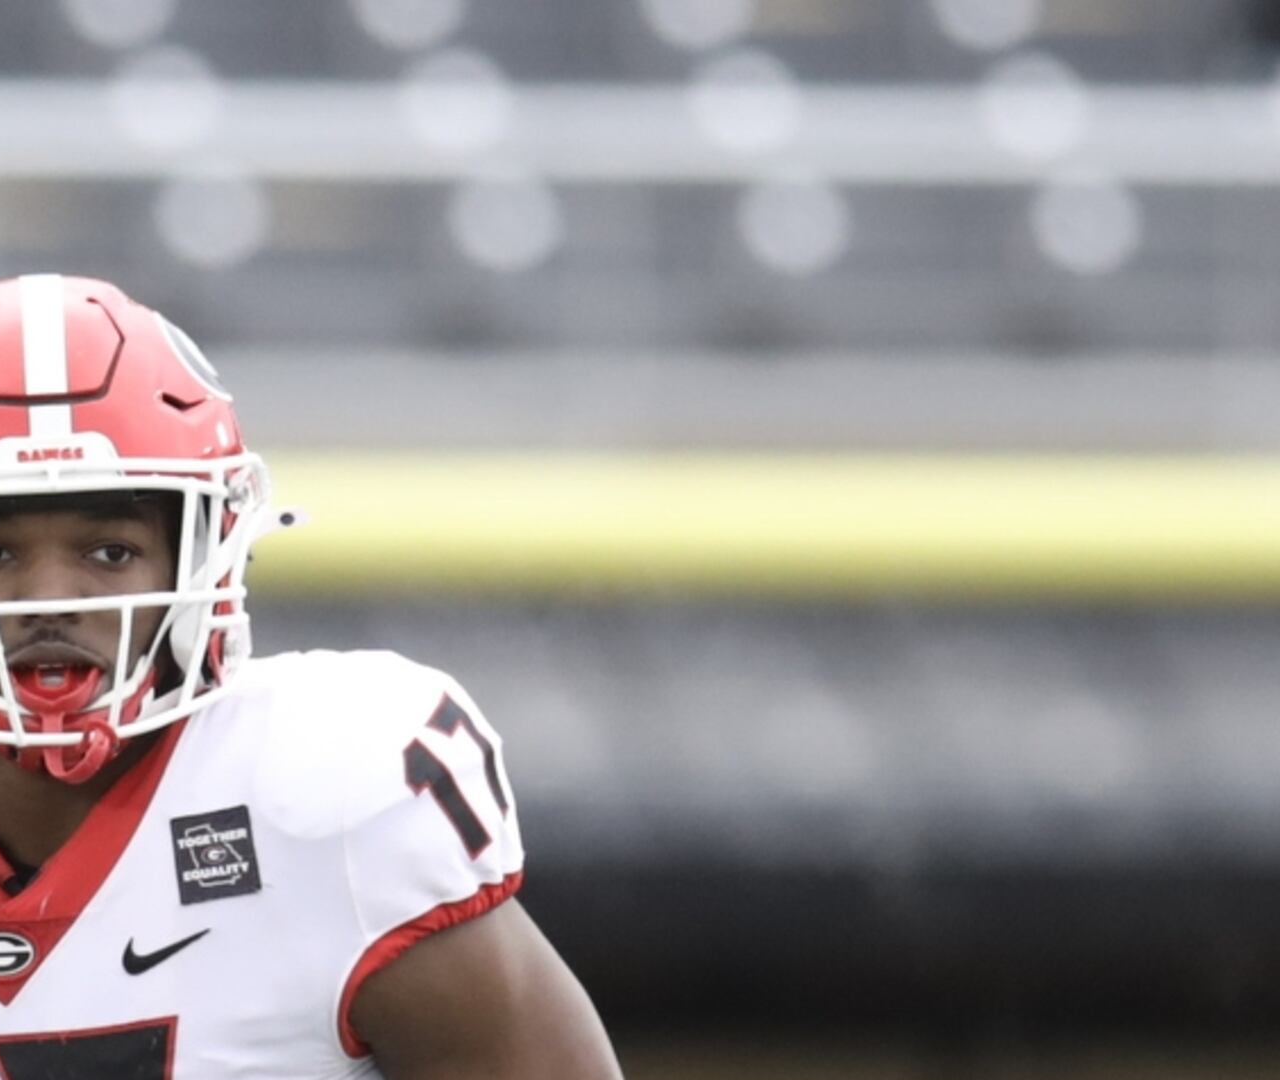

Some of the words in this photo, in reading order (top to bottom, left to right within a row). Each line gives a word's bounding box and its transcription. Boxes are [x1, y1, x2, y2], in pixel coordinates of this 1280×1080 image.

[402, 690, 510, 862] 17
[177, 828, 248, 849] TOGETHER
[182, 862, 250, 882] EQUALITY
